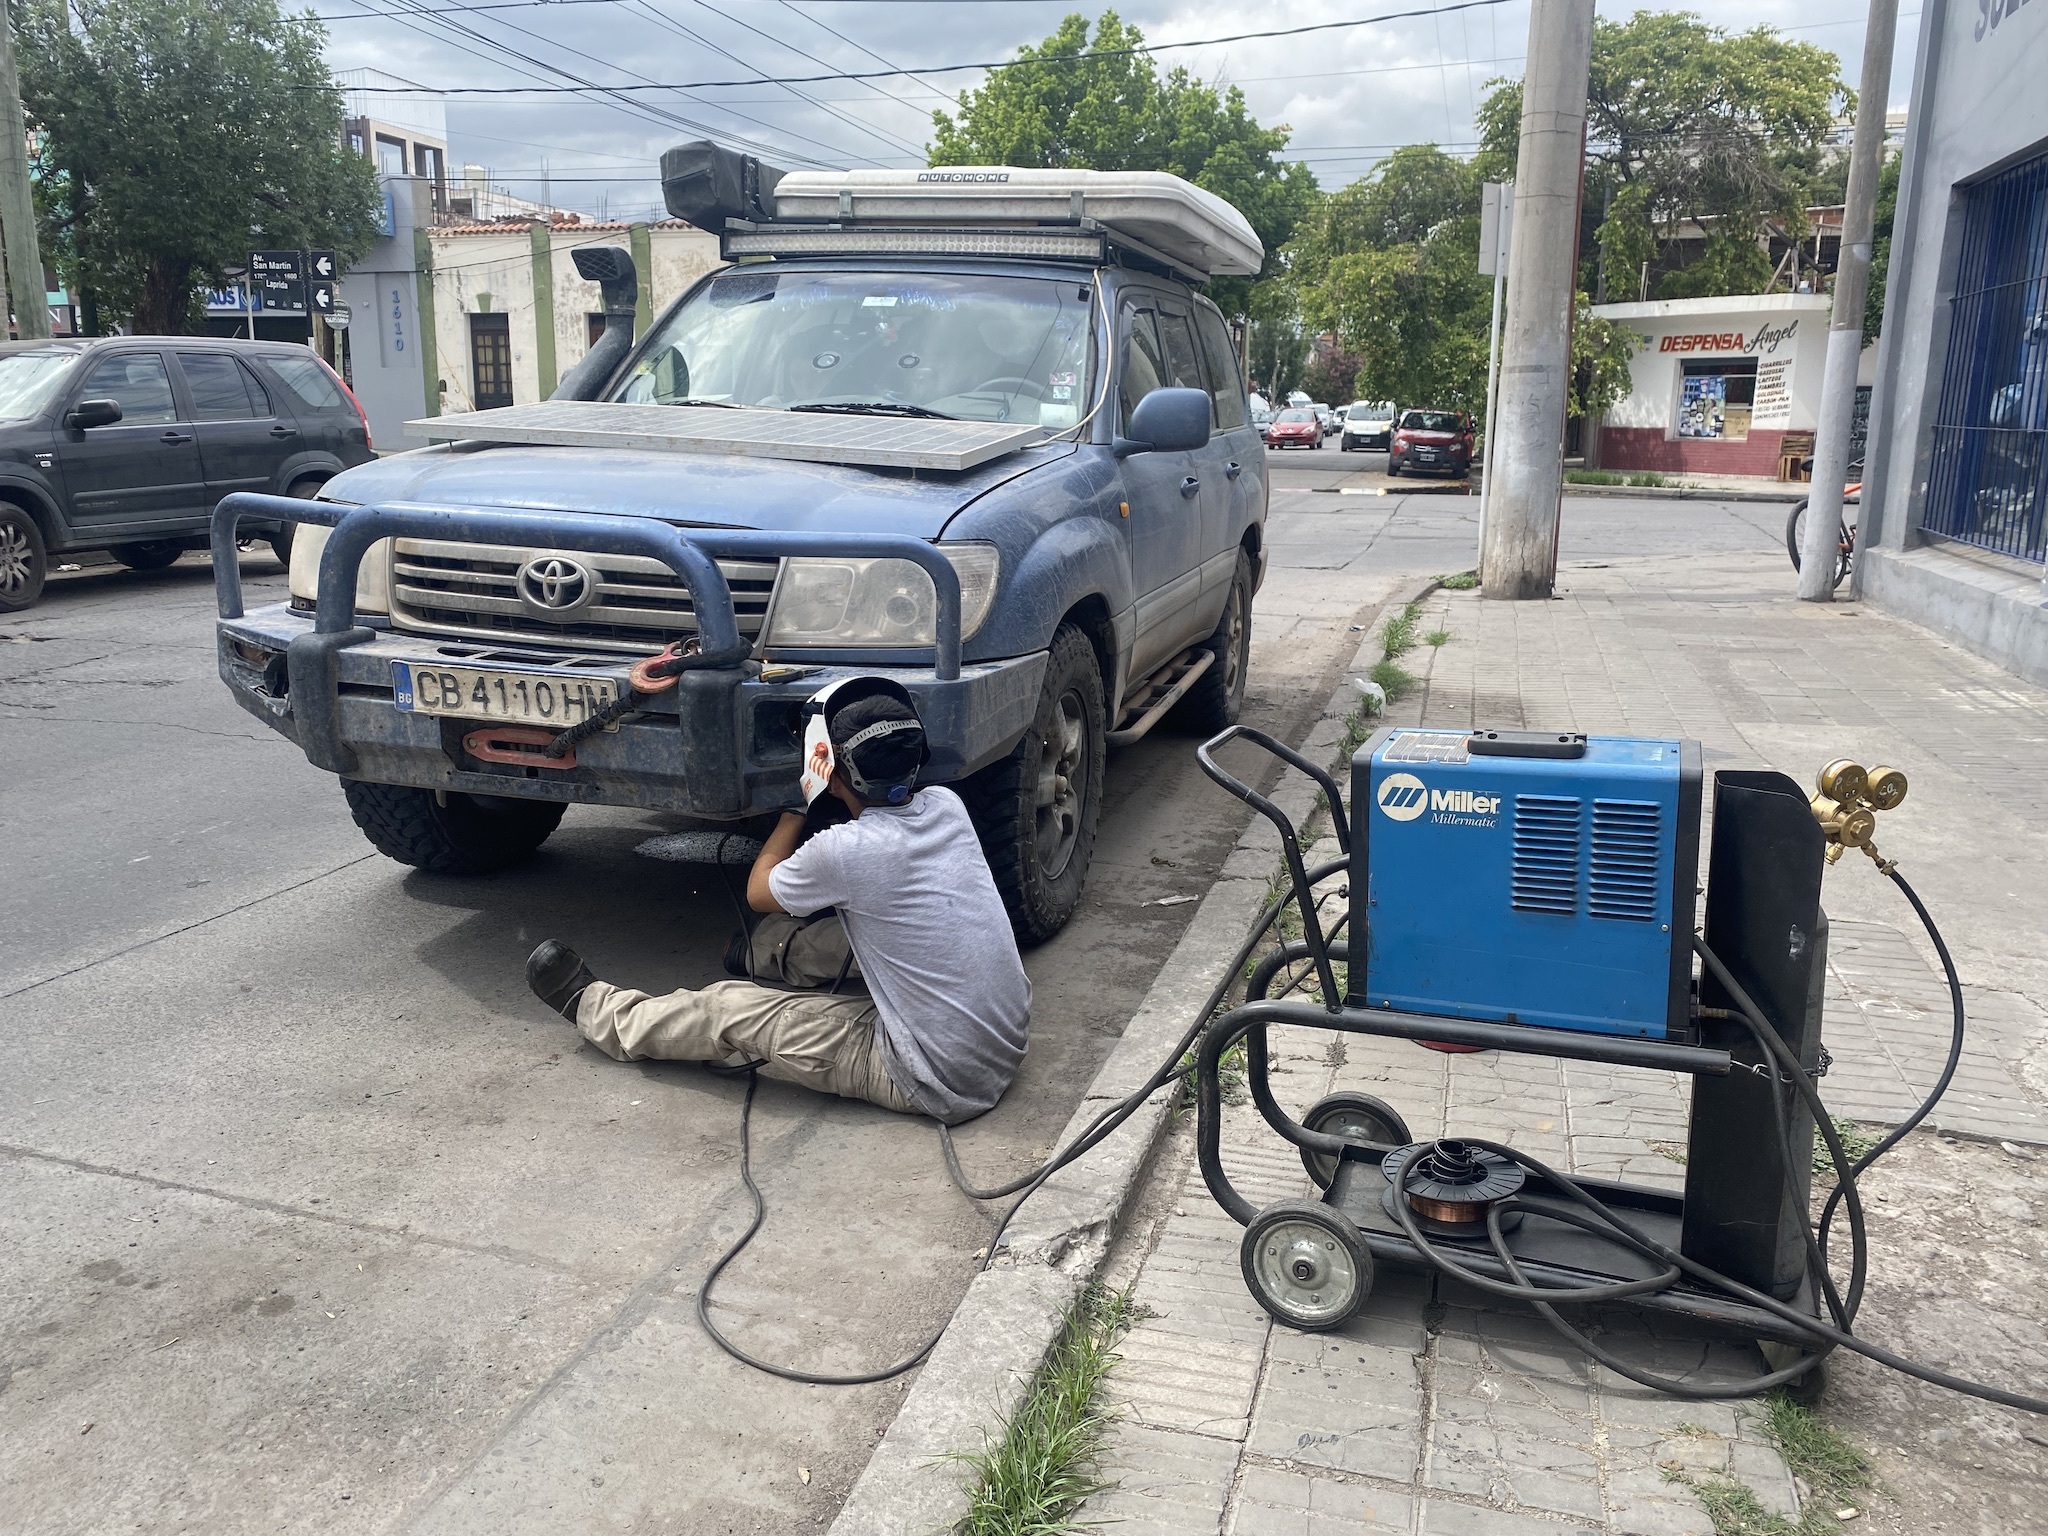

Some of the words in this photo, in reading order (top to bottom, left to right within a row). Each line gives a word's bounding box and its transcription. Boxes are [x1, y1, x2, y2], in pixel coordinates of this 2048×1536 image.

[918, 174, 1009, 182] AUTOHOME
[252, 253, 265, 261] Av.
[253, 261, 268, 270] San
[265, 279, 289, 290] Laprida
[391, 289, 405, 352] 1610
[1659, 333, 1744, 353] DESPENSA
[1744, 319, 1799, 354] Angel
[397, 691, 412, 705] BG
[416, 671, 463, 710] CB
[471, 676, 555, 718] 4110
[562, 682, 611, 720] HM
[1430, 789, 1501, 815] Miller
[1430, 812, 1498, 829] Millermatic
